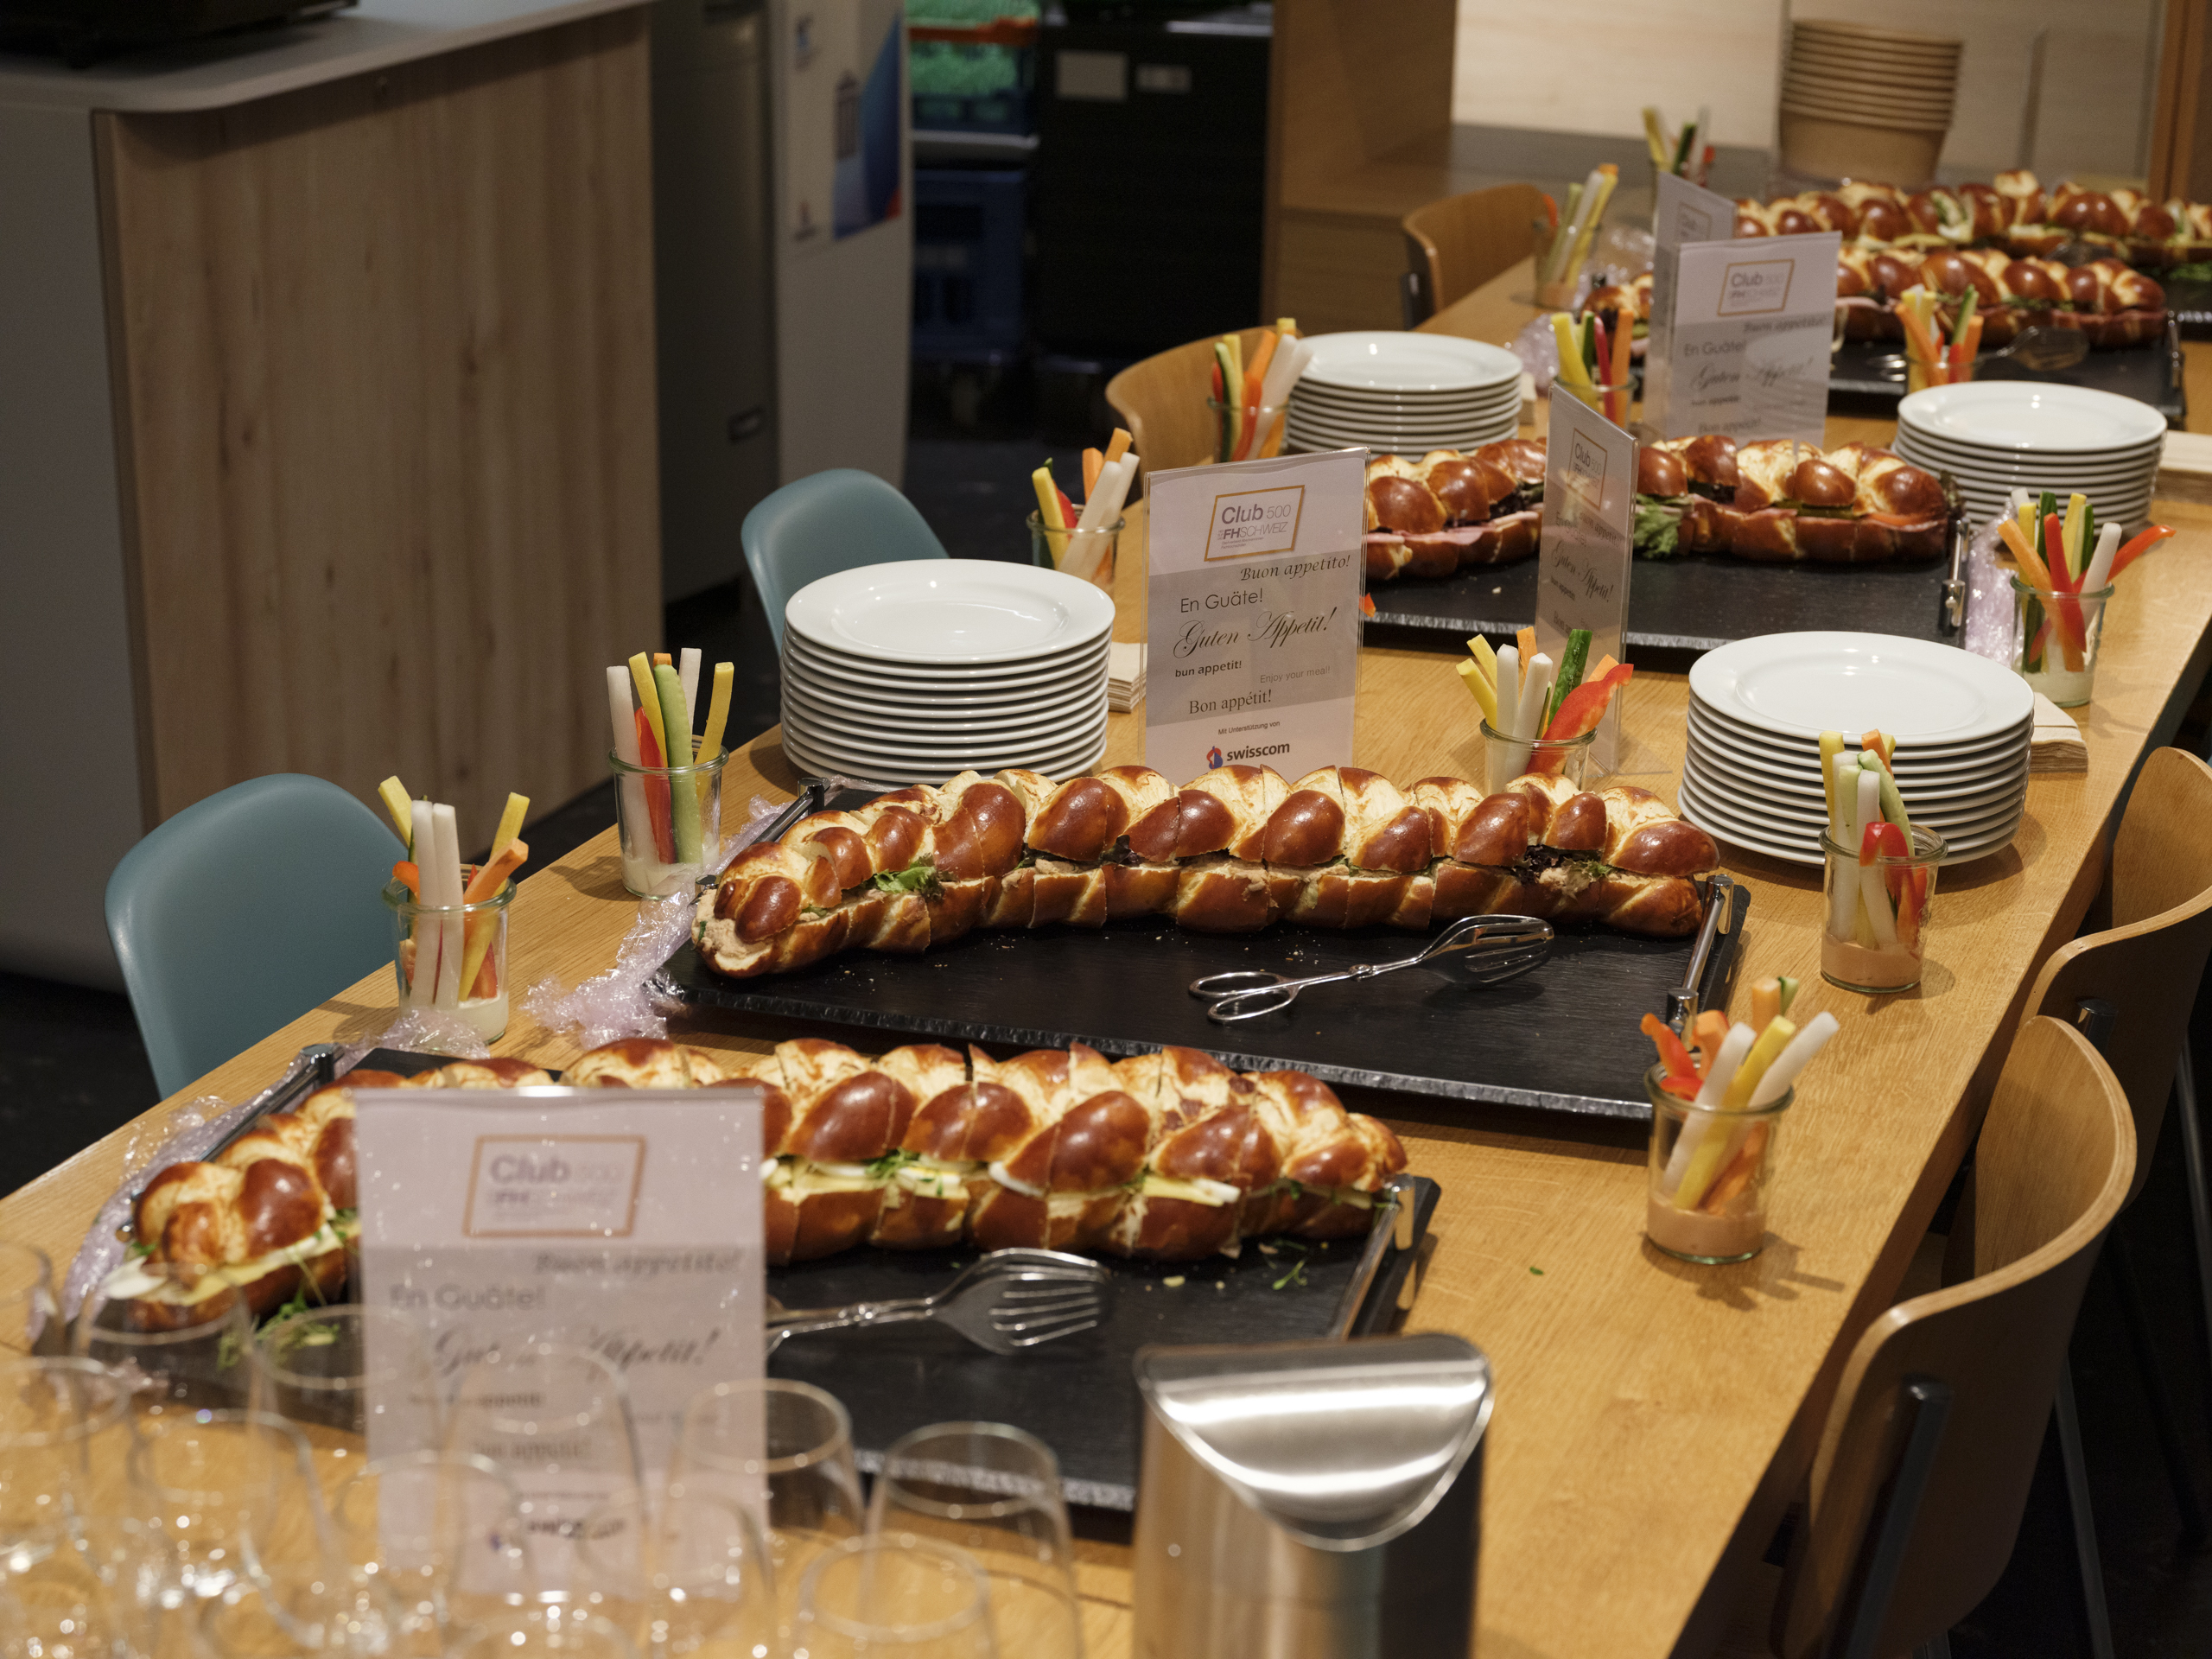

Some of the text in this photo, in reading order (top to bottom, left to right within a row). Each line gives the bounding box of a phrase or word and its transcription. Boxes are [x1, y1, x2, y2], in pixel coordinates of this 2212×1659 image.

[1731, 272, 1764, 288] Club
[1574, 442, 1591, 467] Club
[1221, 504, 1292, 524] Club 500
[1223, 521, 1288, 540] FHSCHWEIZ
[1240, 555, 1351, 582] Buon appetito!
[1552, 540, 1614, 603] Guten Appetit!
[1180, 588, 1263, 613] En Guäte!
[1173, 606, 1338, 658] Guten Appetit!
[1175, 660, 1243, 677] bun appetit!
[1260, 665, 1331, 683] Enjoy your meal!
[1189, 689, 1272, 715] Bon appétit!
[1228, 722, 1268, 734] Unterstützung
[1226, 743, 1290, 761] swisscom
[490, 1153, 571, 1185] Club
